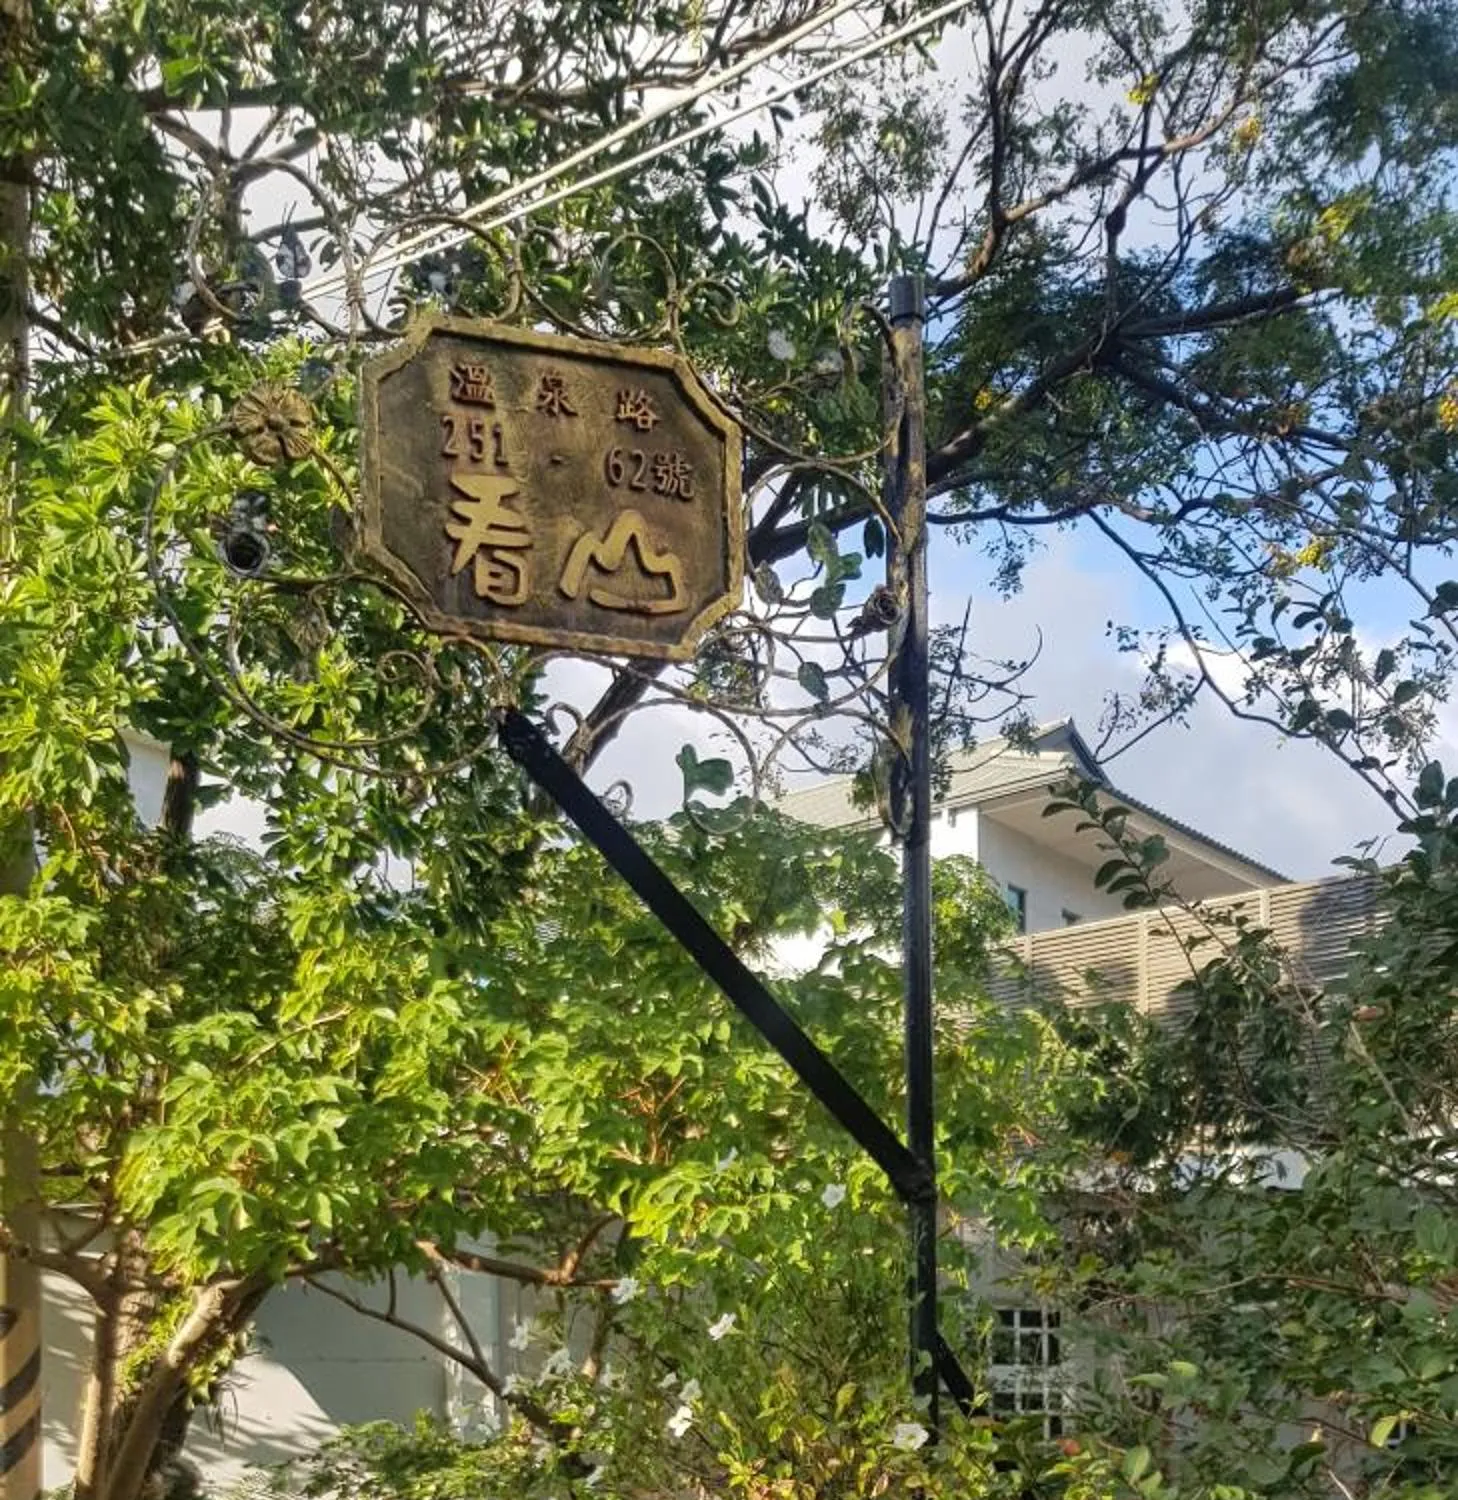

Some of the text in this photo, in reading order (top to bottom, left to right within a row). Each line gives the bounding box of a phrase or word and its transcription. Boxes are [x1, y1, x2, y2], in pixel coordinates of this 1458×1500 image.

[448, 362, 660, 434] 溫泉路
[444, 473, 693, 616] 看山
